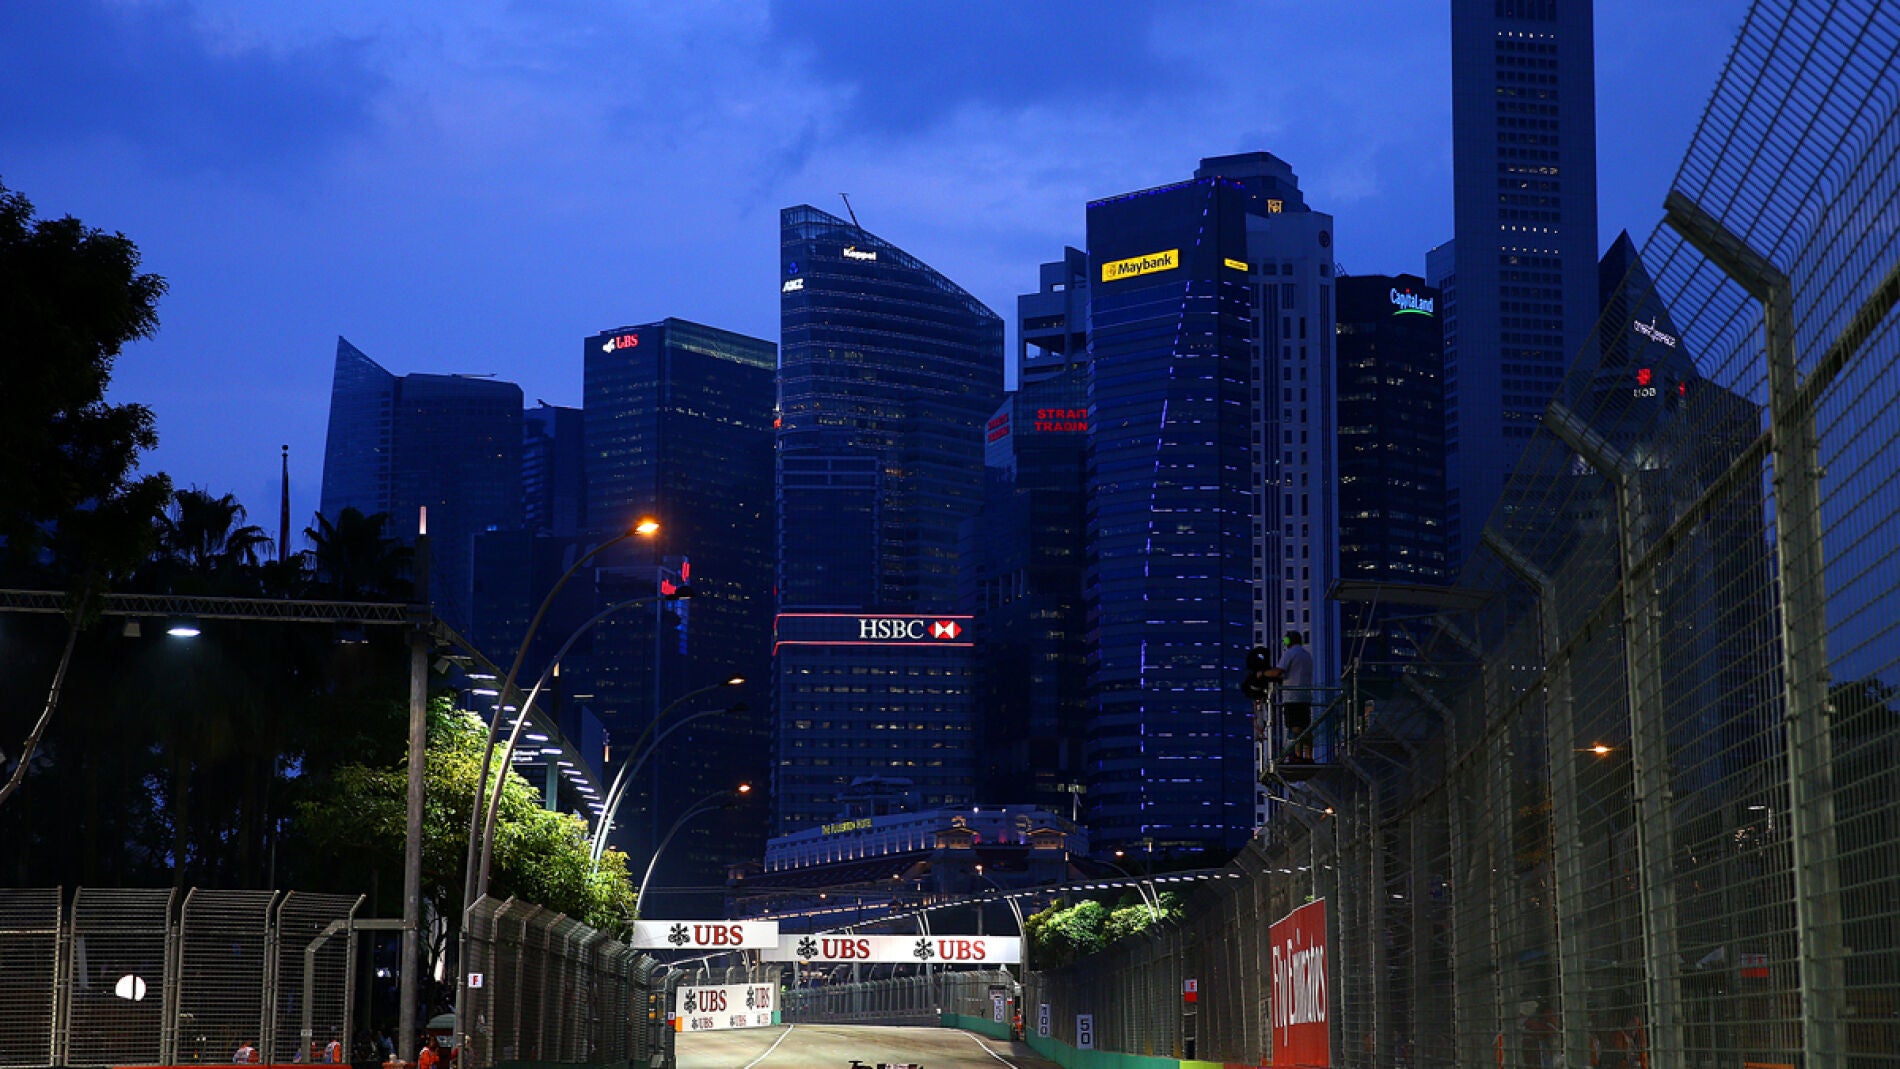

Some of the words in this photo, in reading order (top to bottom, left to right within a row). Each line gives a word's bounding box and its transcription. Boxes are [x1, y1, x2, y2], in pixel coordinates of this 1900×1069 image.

[1117, 254, 1171, 275] Maybank
[1391, 288, 1434, 313] CapitaLand
[616, 334, 639, 349] UBS
[859, 619, 925, 639] HSBC
[694, 925, 743, 946] UBS
[822, 939, 870, 960] UBS
[938, 940, 986, 961] UBS
[472, 975, 479, 986] F
[1272, 945, 1288, 1048] Fly
[1287, 927, 1326, 1026] Emirates
[698, 989, 728, 1013] UBS
[1081, 1018, 1091, 1045] 50
